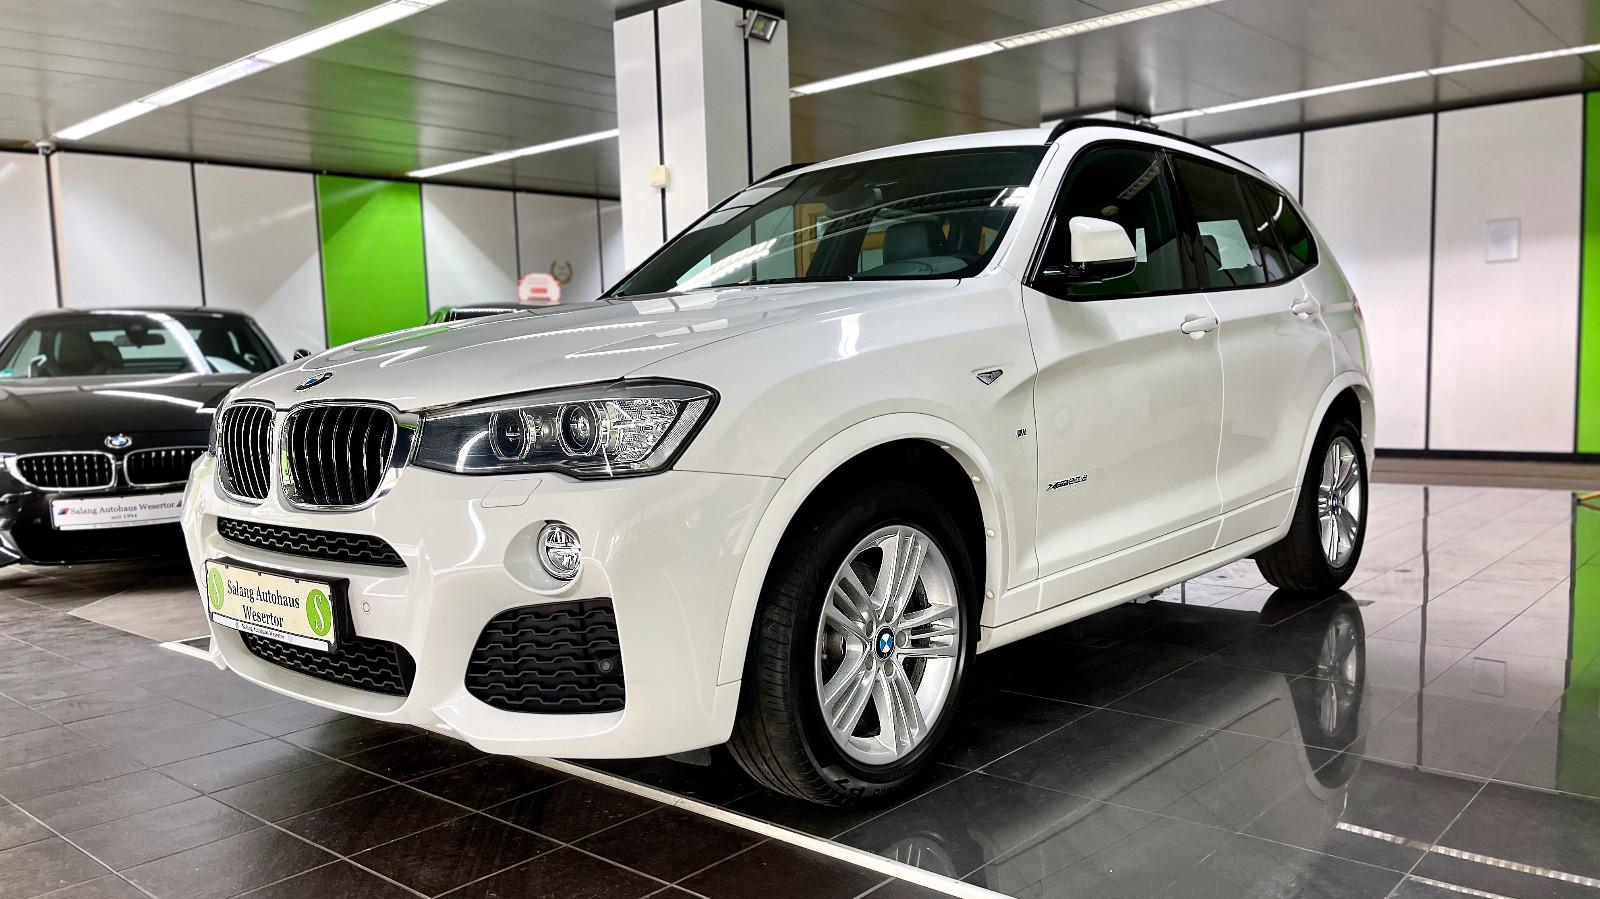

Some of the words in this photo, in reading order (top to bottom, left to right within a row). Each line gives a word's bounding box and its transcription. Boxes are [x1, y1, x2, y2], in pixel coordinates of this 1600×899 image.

[70, 506, 98, 516] Salang
[99, 504, 138, 514] Autohaus
[139, 501, 176, 511] Wesertor
[227, 579, 255, 603] Salang
[256, 586, 300, 609] Autohaus
[242, 604, 284, 628] Wesertor
